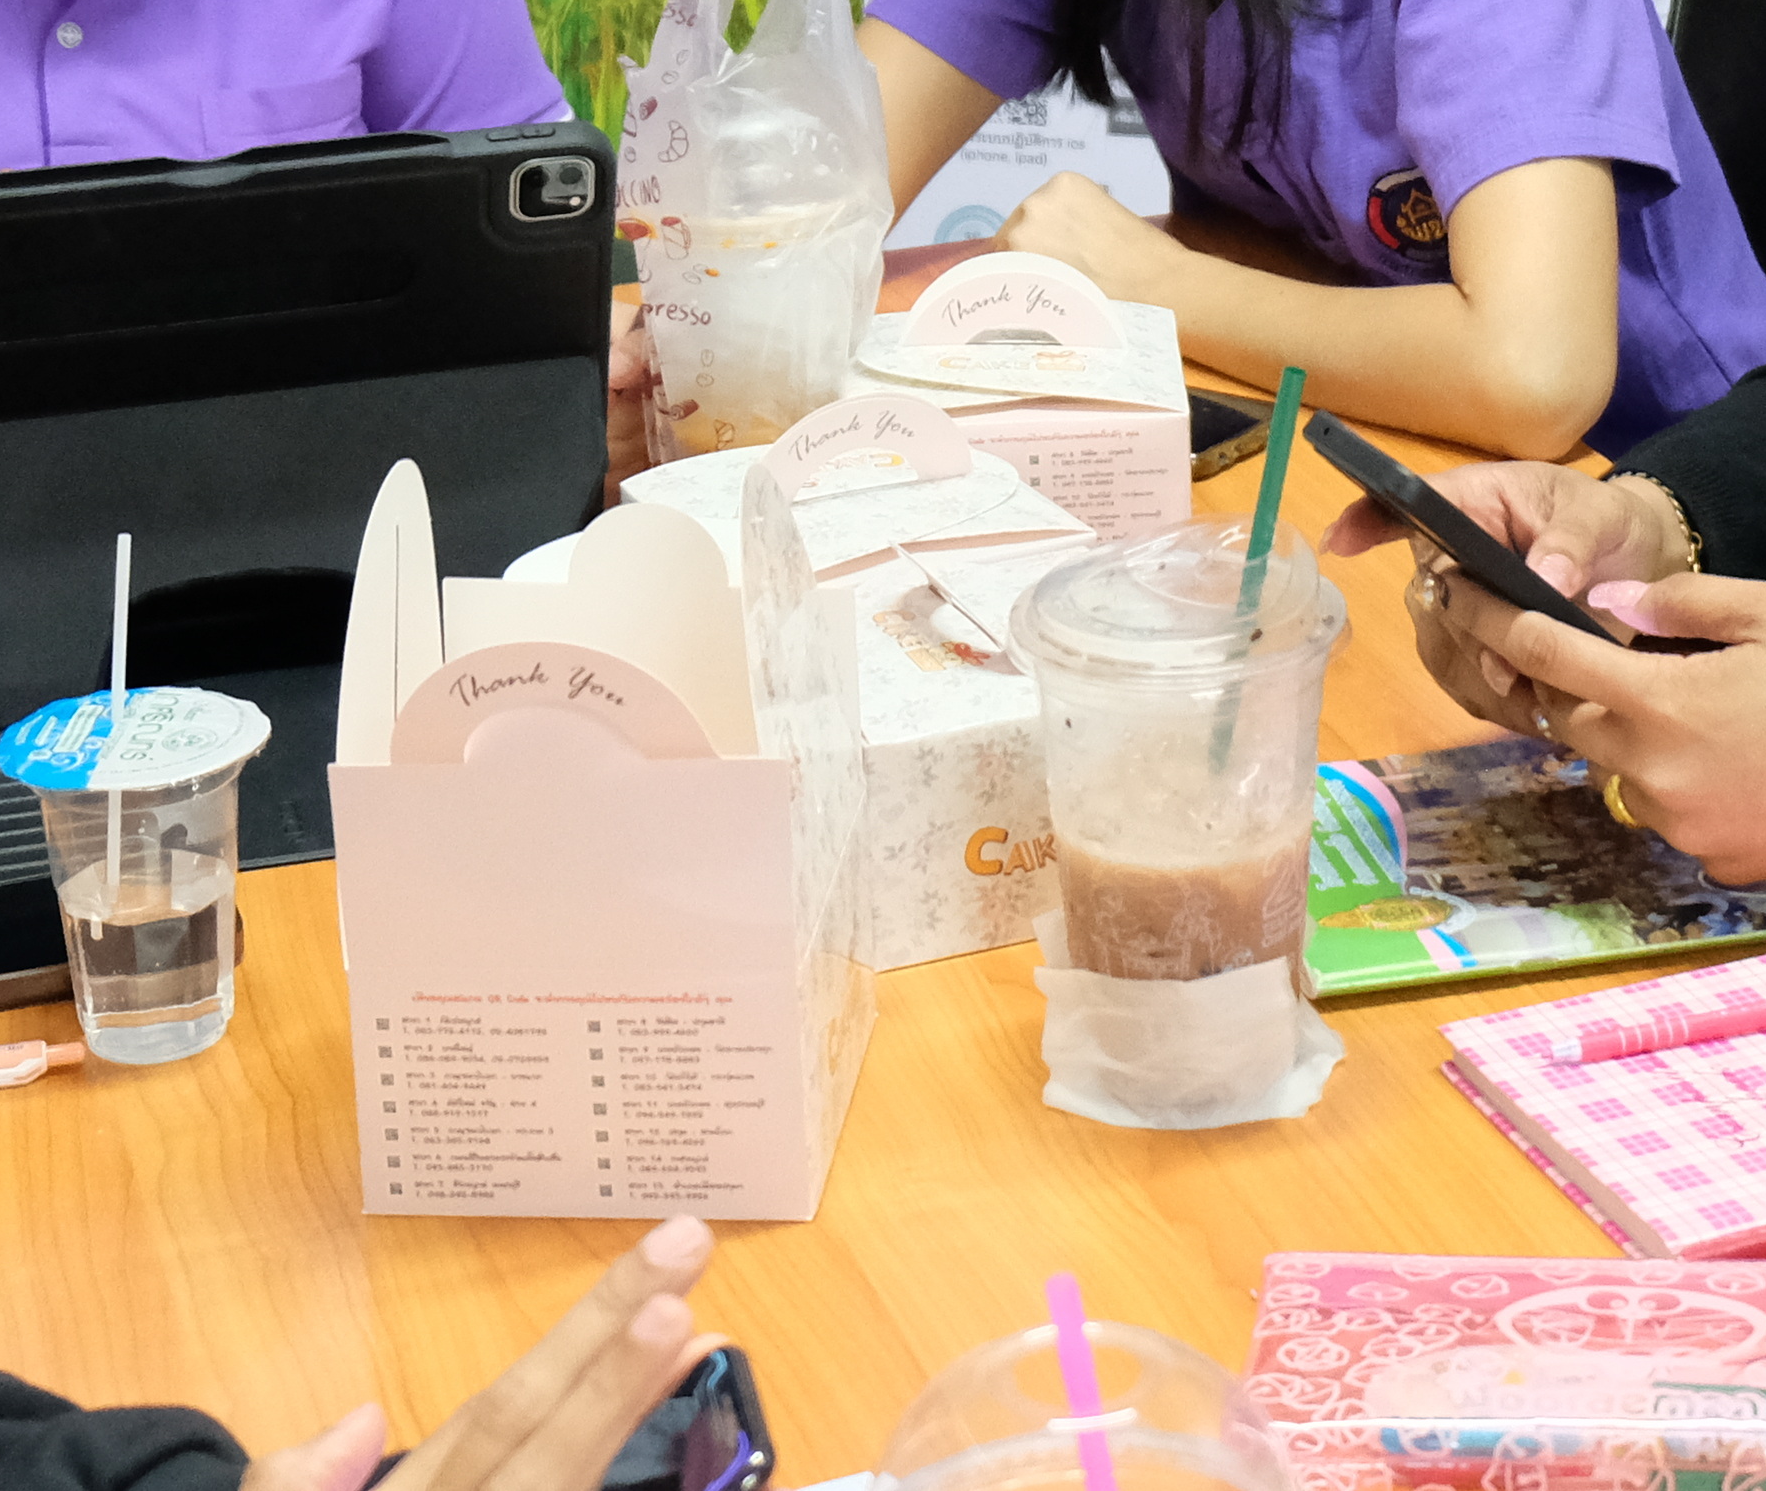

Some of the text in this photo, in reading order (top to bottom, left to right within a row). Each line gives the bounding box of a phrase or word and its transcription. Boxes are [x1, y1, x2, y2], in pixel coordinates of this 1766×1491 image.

[941, 283, 1067, 327] Thank You
[788, 410, 916, 461] Thank You
[449, 662, 625, 707] Thank You
[964, 826, 1058, 876] CAK
